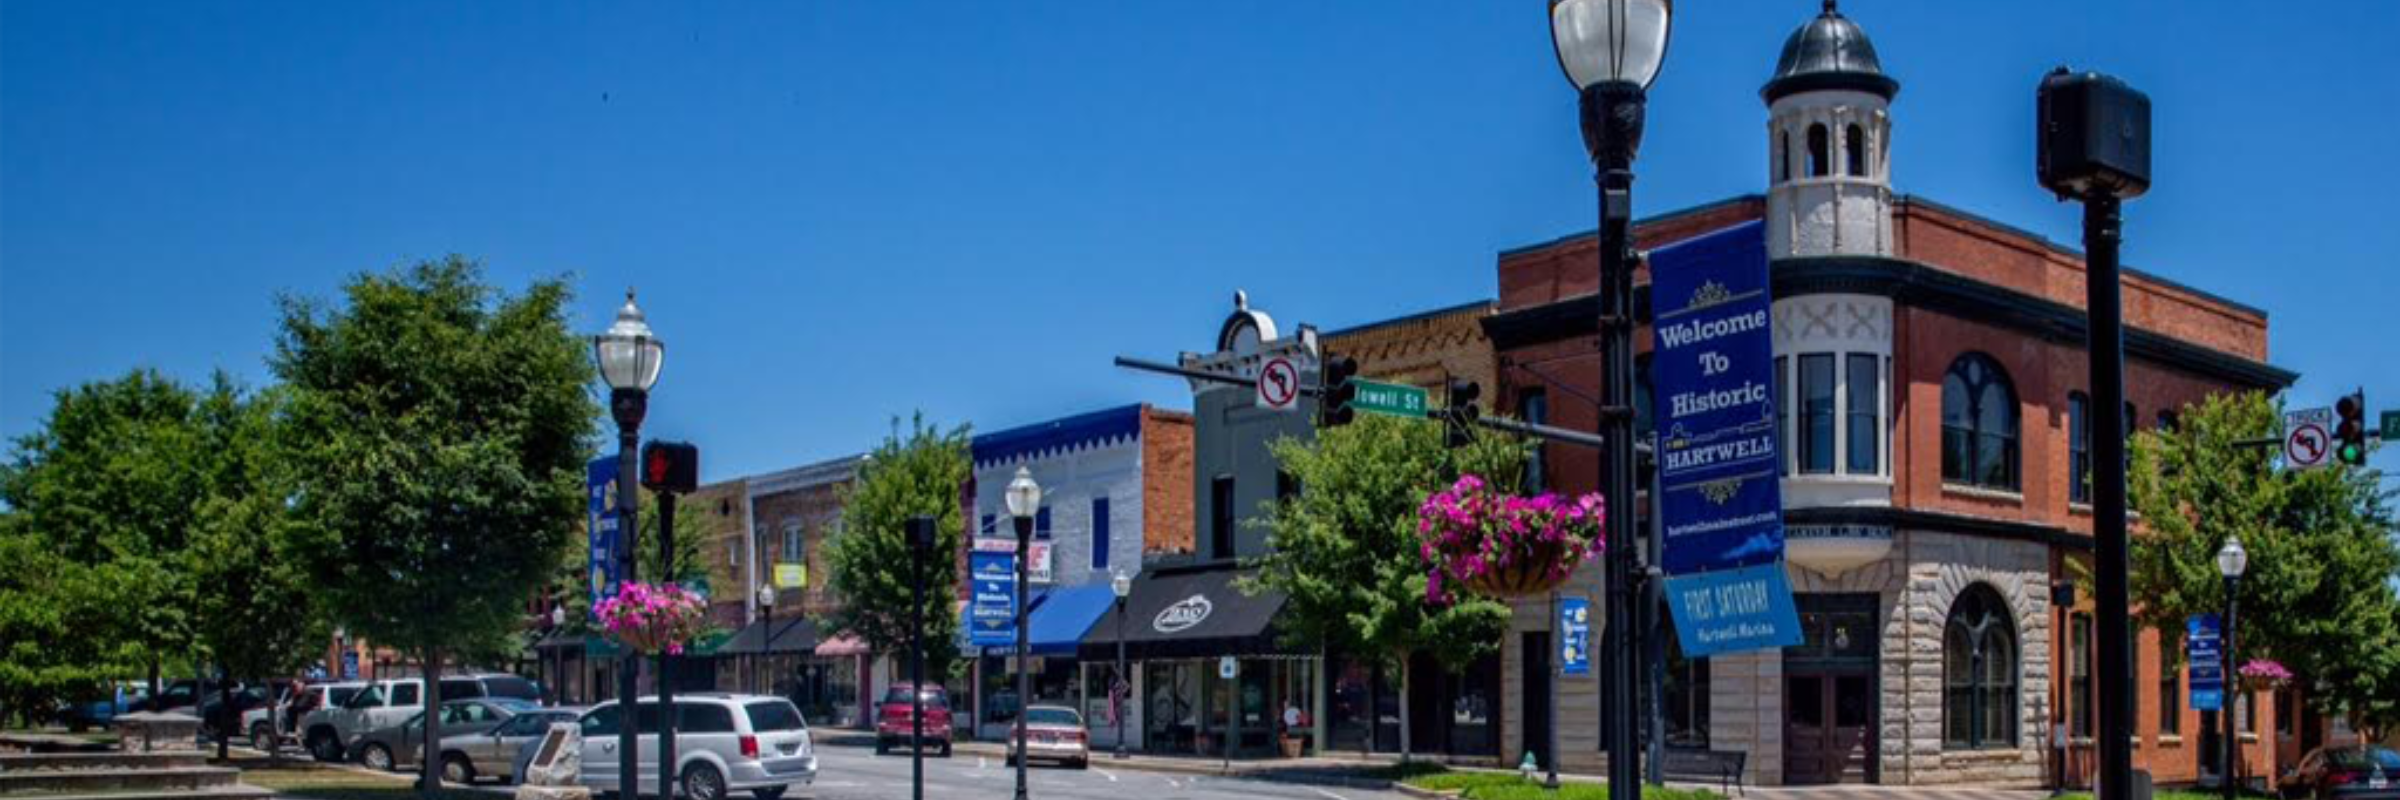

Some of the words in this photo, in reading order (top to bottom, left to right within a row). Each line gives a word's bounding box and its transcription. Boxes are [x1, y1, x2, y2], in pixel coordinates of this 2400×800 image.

[1659, 309, 1766, 349] Welcome
[1699, 352, 1729, 376] To
[1405, 392, 1419, 411] St
[1671, 380, 1766, 418] Historic
[1666, 436, 1772, 470] HARTWELL
[1684, 587, 1713, 623] FIRST
[1715, 579, 1769, 617] SATURDAY
[1697, 624, 1737, 642] Hartwell
[1739, 622, 1775, 637] Marina
